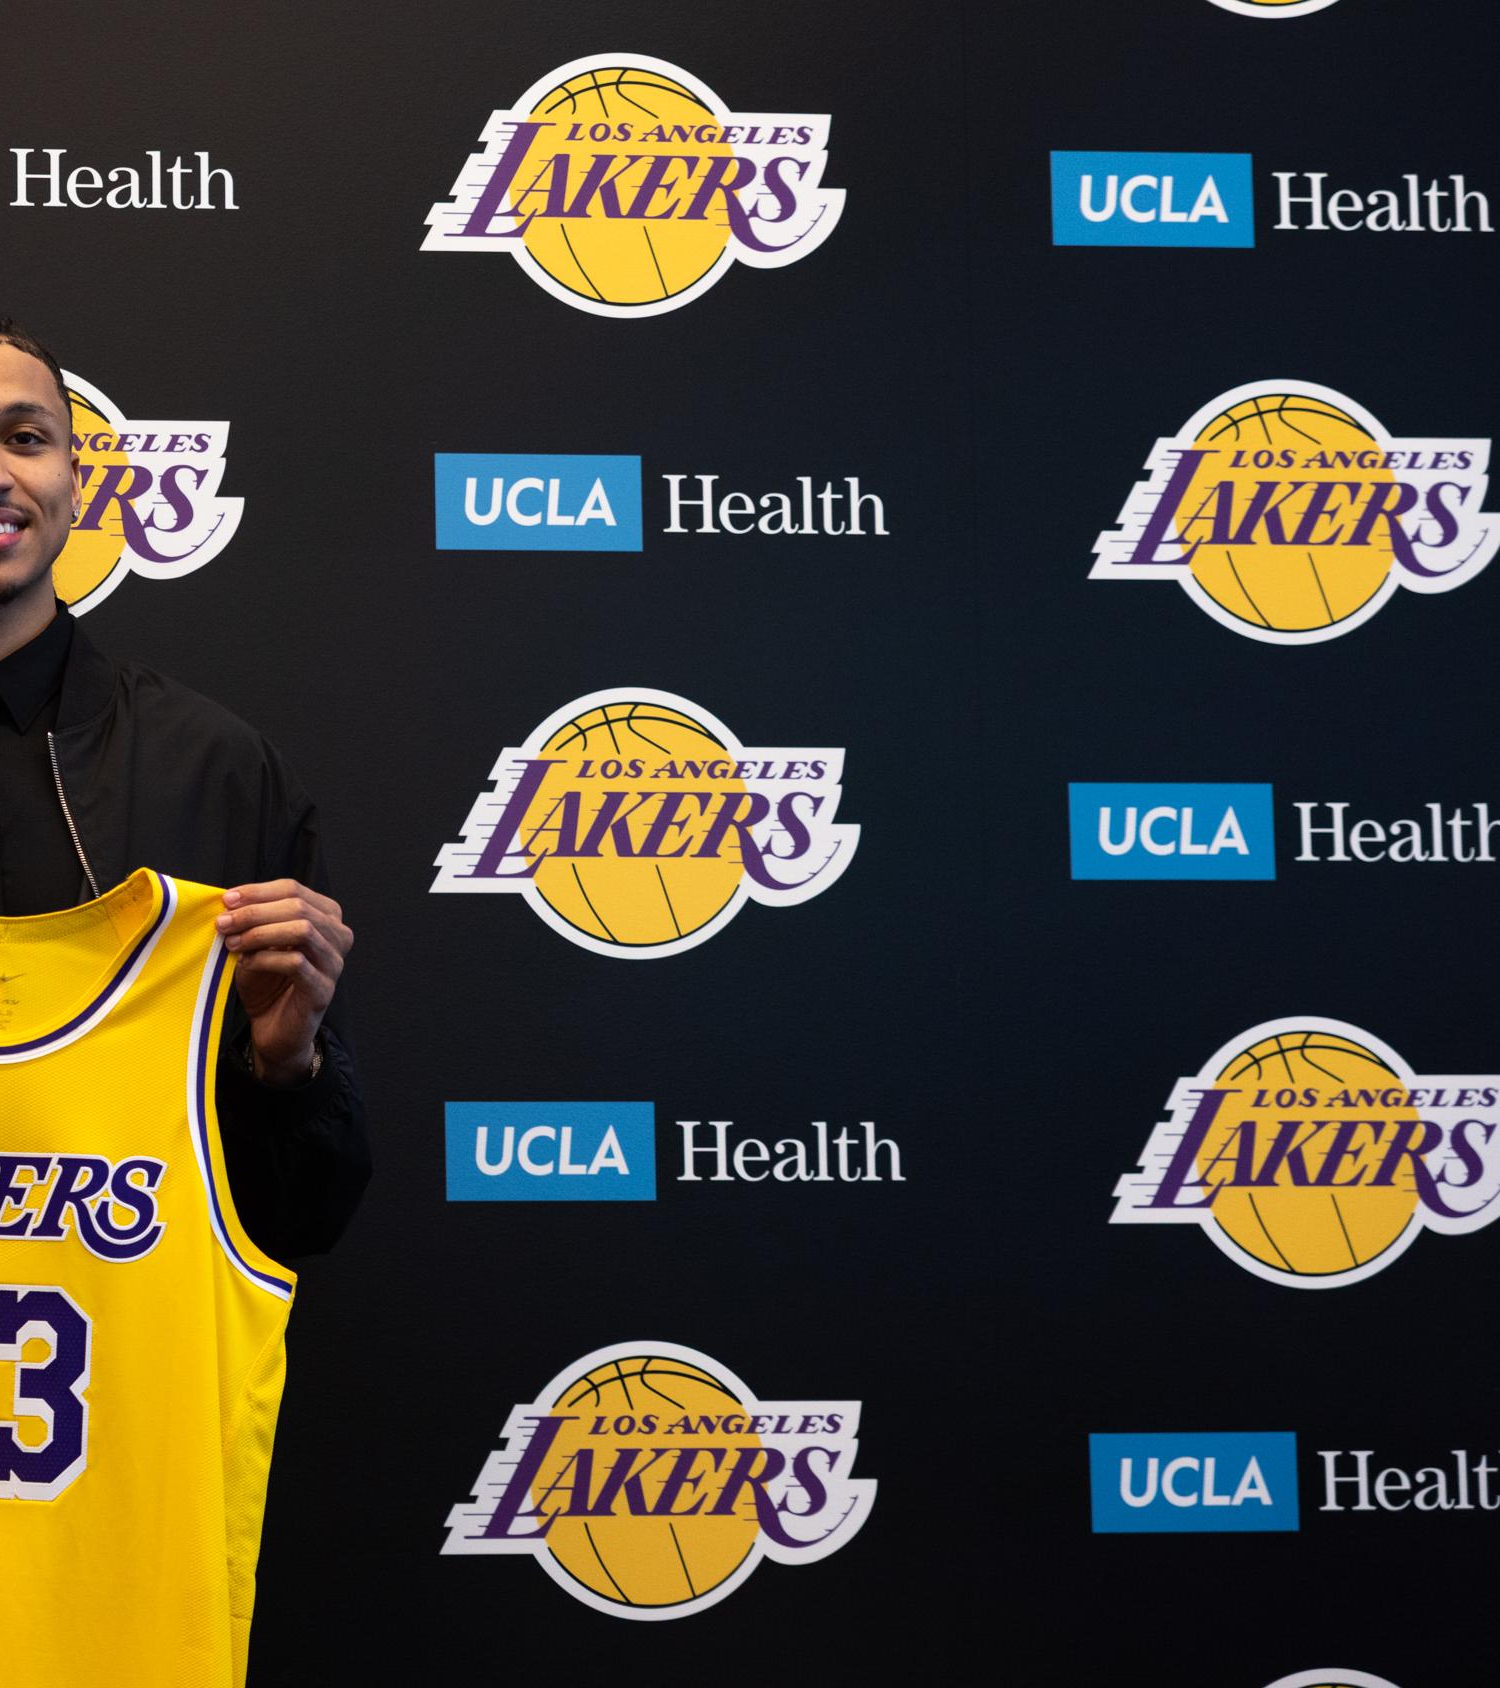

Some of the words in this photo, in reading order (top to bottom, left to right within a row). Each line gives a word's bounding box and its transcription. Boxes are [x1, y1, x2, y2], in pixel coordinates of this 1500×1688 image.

[565, 123, 631, 142] LOS
[638, 125, 810, 145] ANGELES
[10, 148, 239, 210] Health
[443, 122, 827, 252] LAKERS
[1080, 175, 1229, 223] UCLA
[1272, 172, 1495, 232] Health
[71, 432, 211, 453] NGELES
[1229, 450, 1297, 469] LOS
[1300, 450, 1472, 470] ANGELES
[465, 477, 616, 526] UCLA
[662, 475, 889, 535] Health
[1111, 449, 1489, 577] LAKERS
[576, 759, 645, 779] LOS
[650, 760, 826, 779] ANGELES
[453, 758, 842, 890] LAKERS
[1098, 806, 1249, 855] UCLA
[1252, 1088, 1320, 1108] LOS
[1326, 1088, 1498, 1108] ANGELES
[476, 1126, 629, 1175] UCLA
[676, 1121, 905, 1182] Health
[1131, 1089, 1500, 1218] LAKERS
[588, 1415, 659, 1435] LOS
[663, 1414, 843, 1434] ANGELES
[464, 1412, 857, 1549] LAKERS
[1120, 1456, 1272, 1508] UCLA
[1318, 1449, 1500, 1511] Healt
